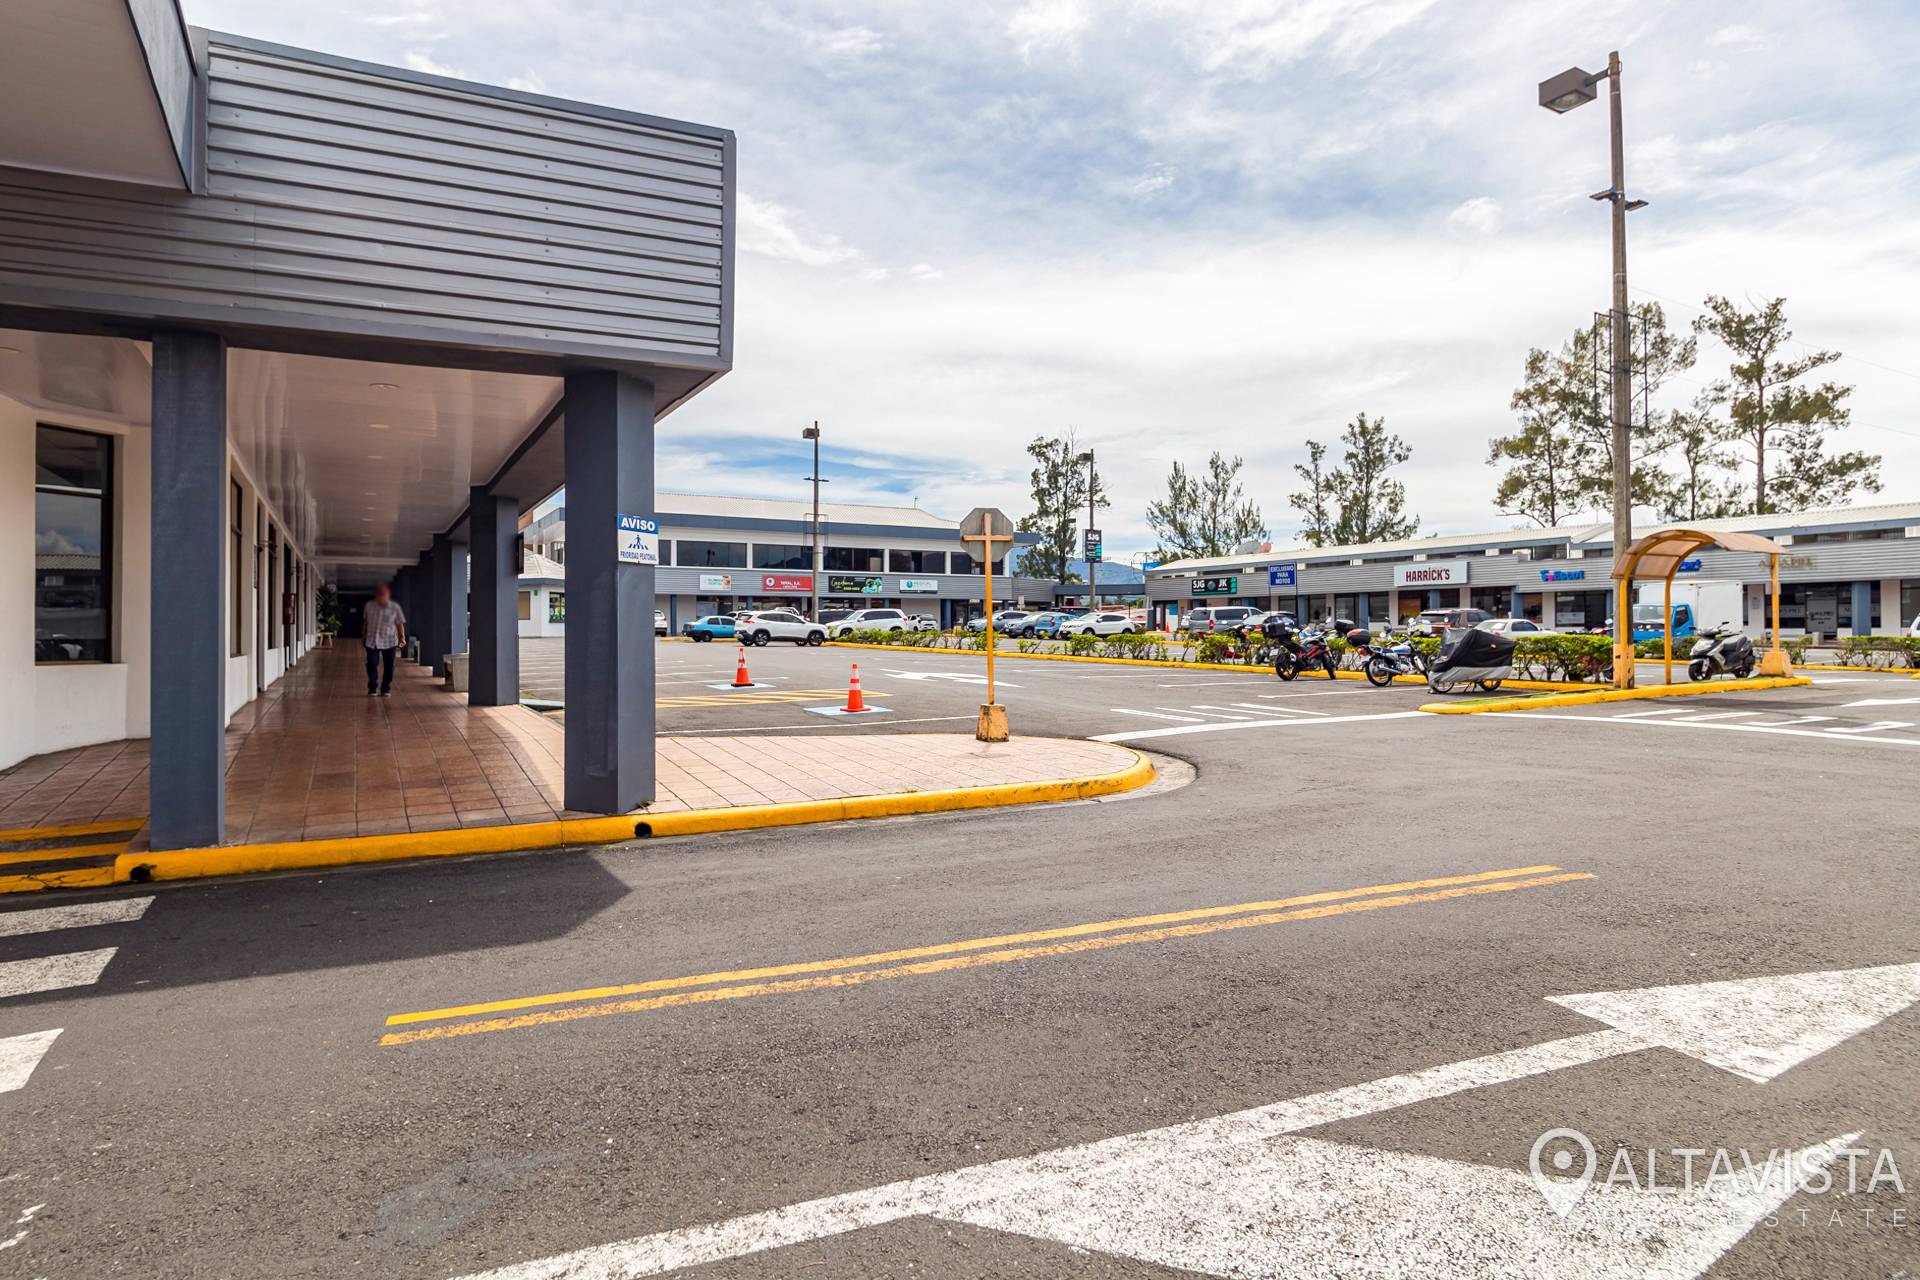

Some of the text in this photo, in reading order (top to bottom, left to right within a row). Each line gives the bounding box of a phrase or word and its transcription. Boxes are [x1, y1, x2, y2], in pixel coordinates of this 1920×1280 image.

[621, 517, 656, 531] AVISO
[1270, 565, 1294, 573] EXCLUSIVO
[1192, 579, 1206, 589] SJG
[1218, 578, 1228, 588] JK
